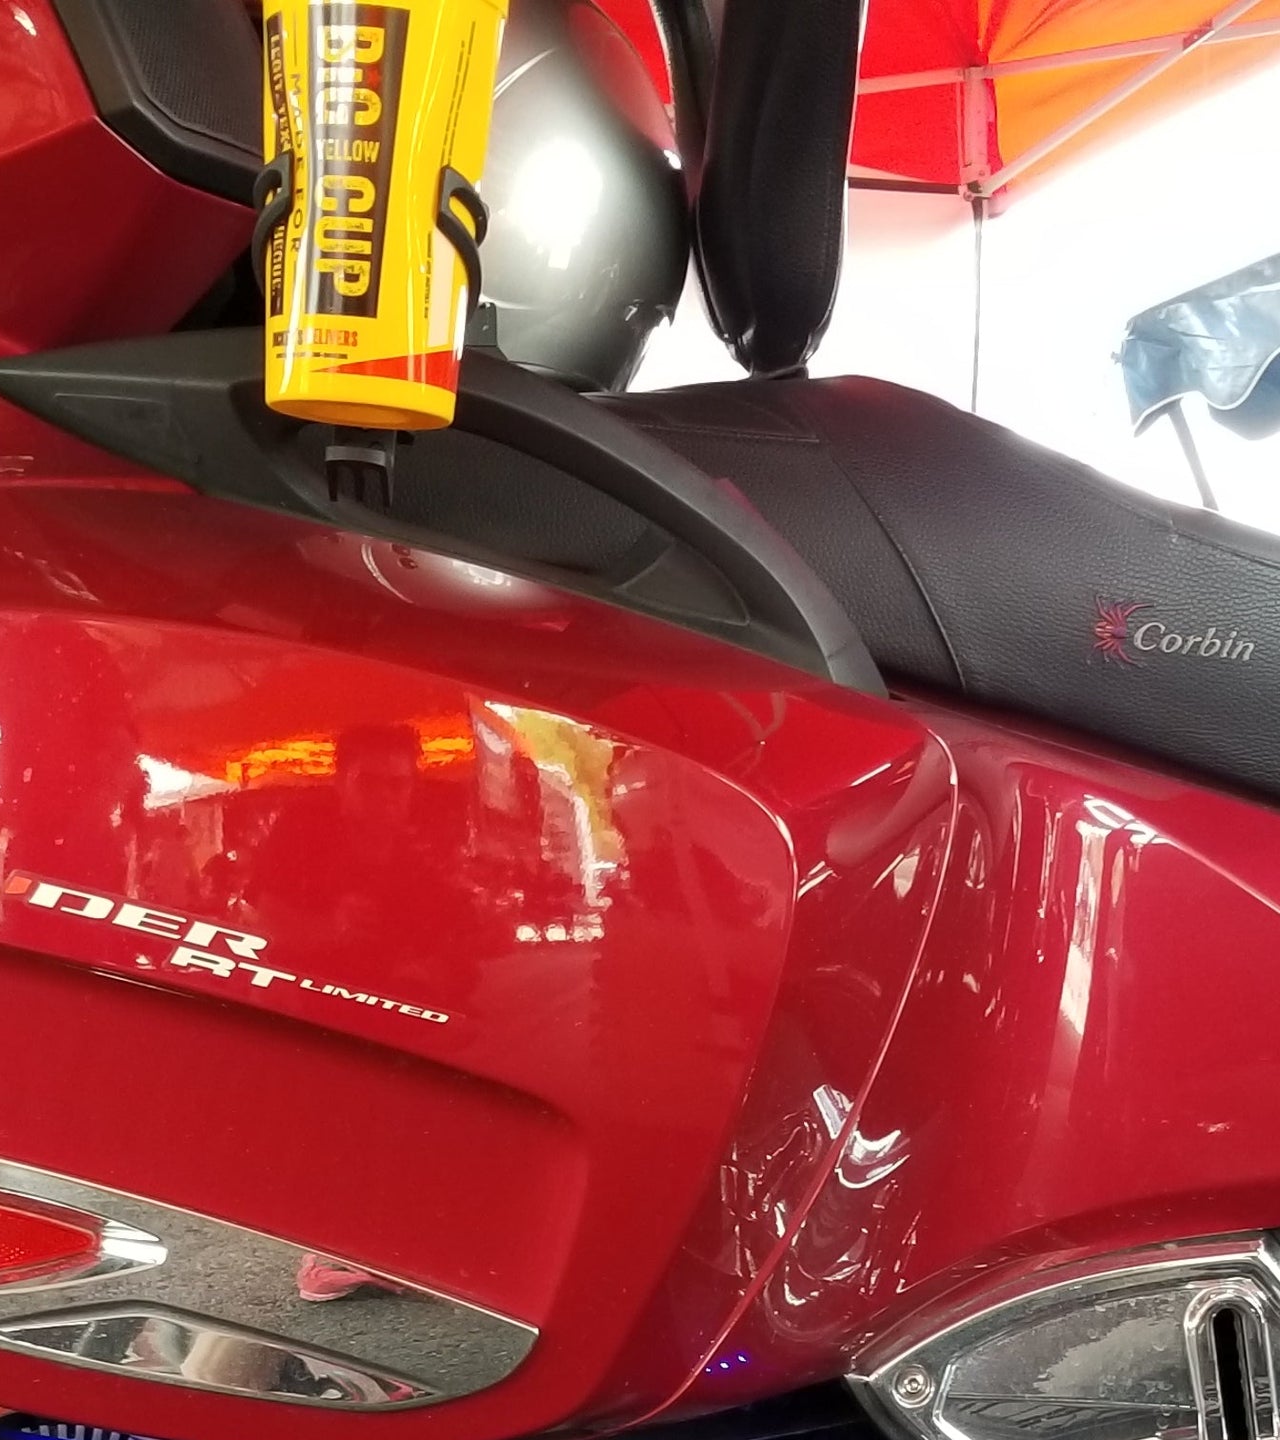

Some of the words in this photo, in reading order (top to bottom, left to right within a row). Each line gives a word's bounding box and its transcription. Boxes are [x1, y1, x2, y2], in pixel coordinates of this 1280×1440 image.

[314, 25, 386, 125] BIG
[316, 139, 380, 163] YELLOW
[314, 174, 377, 298] CUP
[1133, 621, 1256, 662] Corbin
[170, 946, 297, 989] RT
[299, 978, 450, 1024] LIMITED
